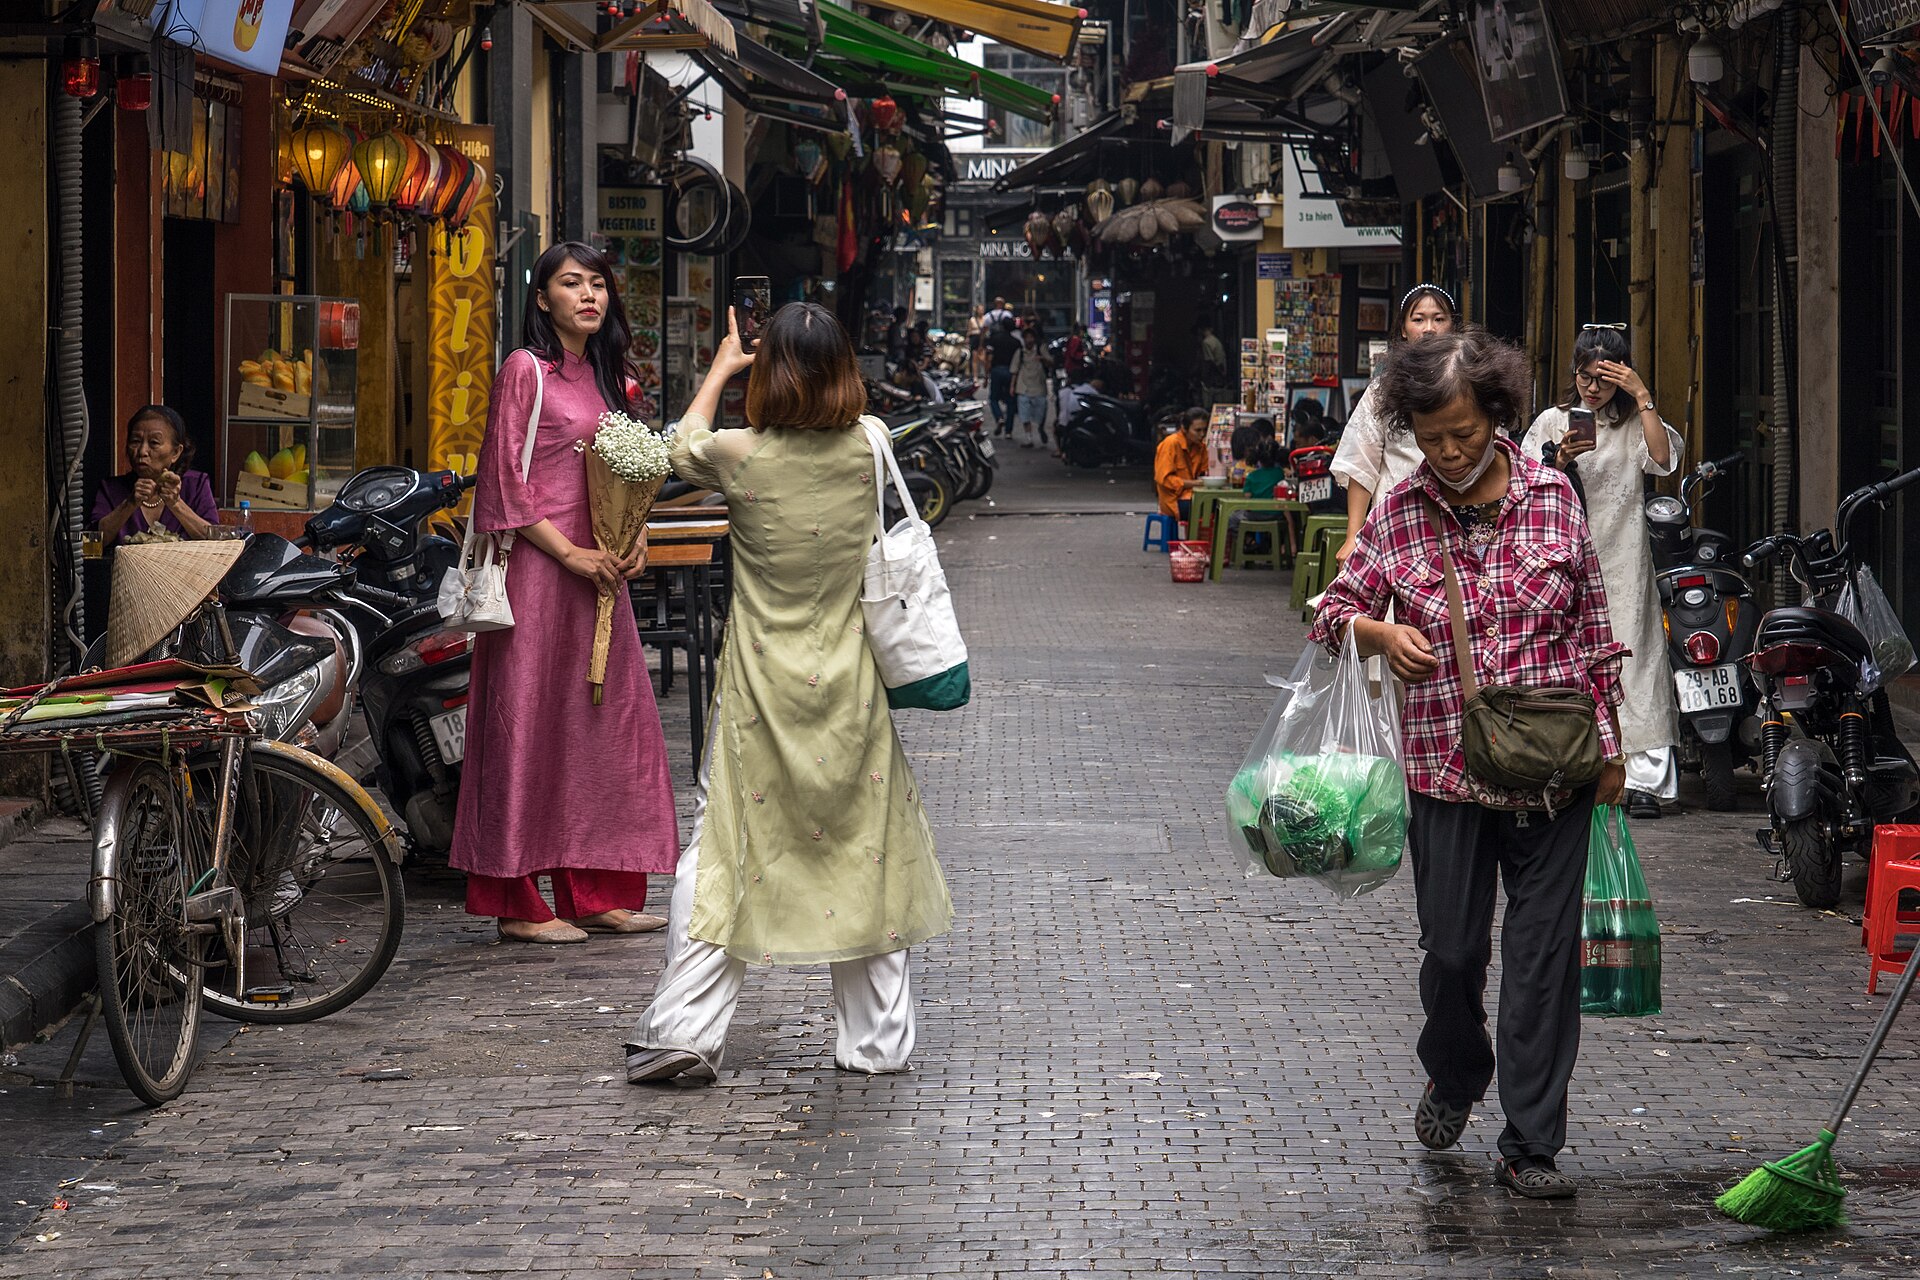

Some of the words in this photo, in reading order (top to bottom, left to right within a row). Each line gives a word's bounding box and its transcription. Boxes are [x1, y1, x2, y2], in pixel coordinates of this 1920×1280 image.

[967, 158, 1018, 179] MINA
[608, 196, 647, 209] BISTRO
[1298, 211, 1304, 222] 3
[1315, 211, 1333, 221] hien
[599, 217, 656, 231] VEGETABLE
[979, 242, 1010, 257] MINA
[412, 604, 438, 615] PIAGG
[1685, 667, 1729, 691] 29-AB
[1683, 686, 1738, 709] 181.68
